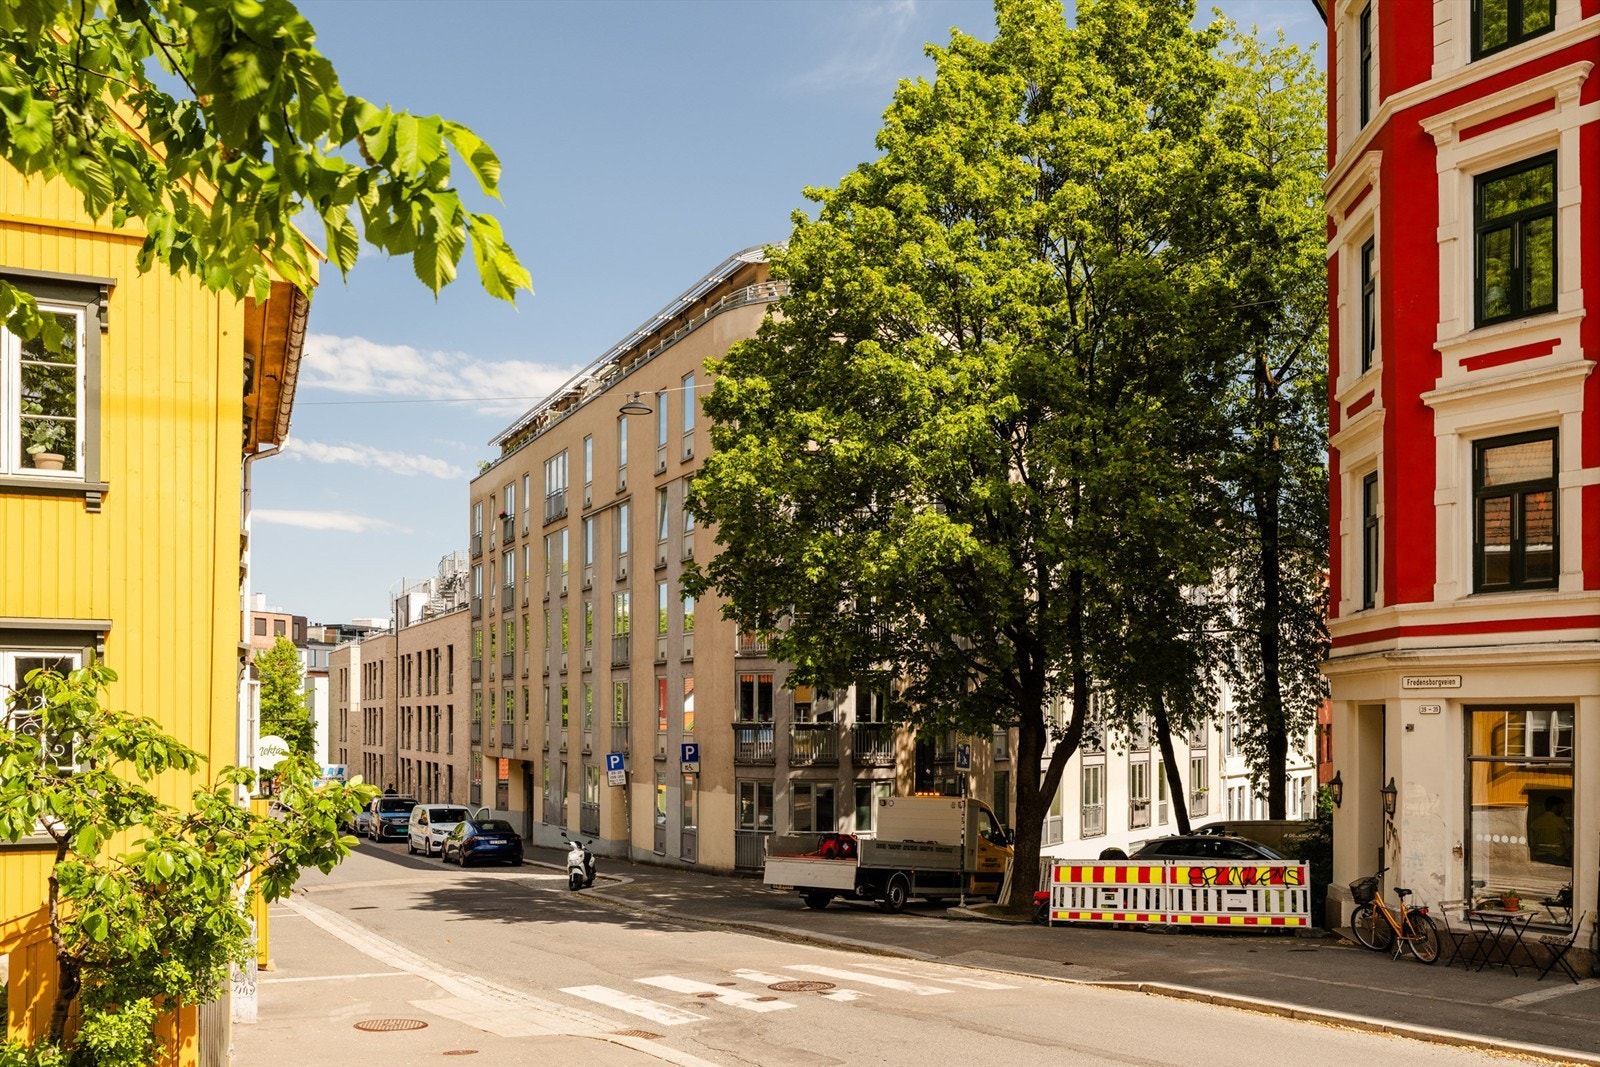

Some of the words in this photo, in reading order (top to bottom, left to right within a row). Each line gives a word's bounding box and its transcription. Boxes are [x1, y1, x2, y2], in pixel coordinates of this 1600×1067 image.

[1406, 678, 1456, 688] Fredensborgveien
[685, 745, 695, 760] P
[610, 755, 620, 769] P
